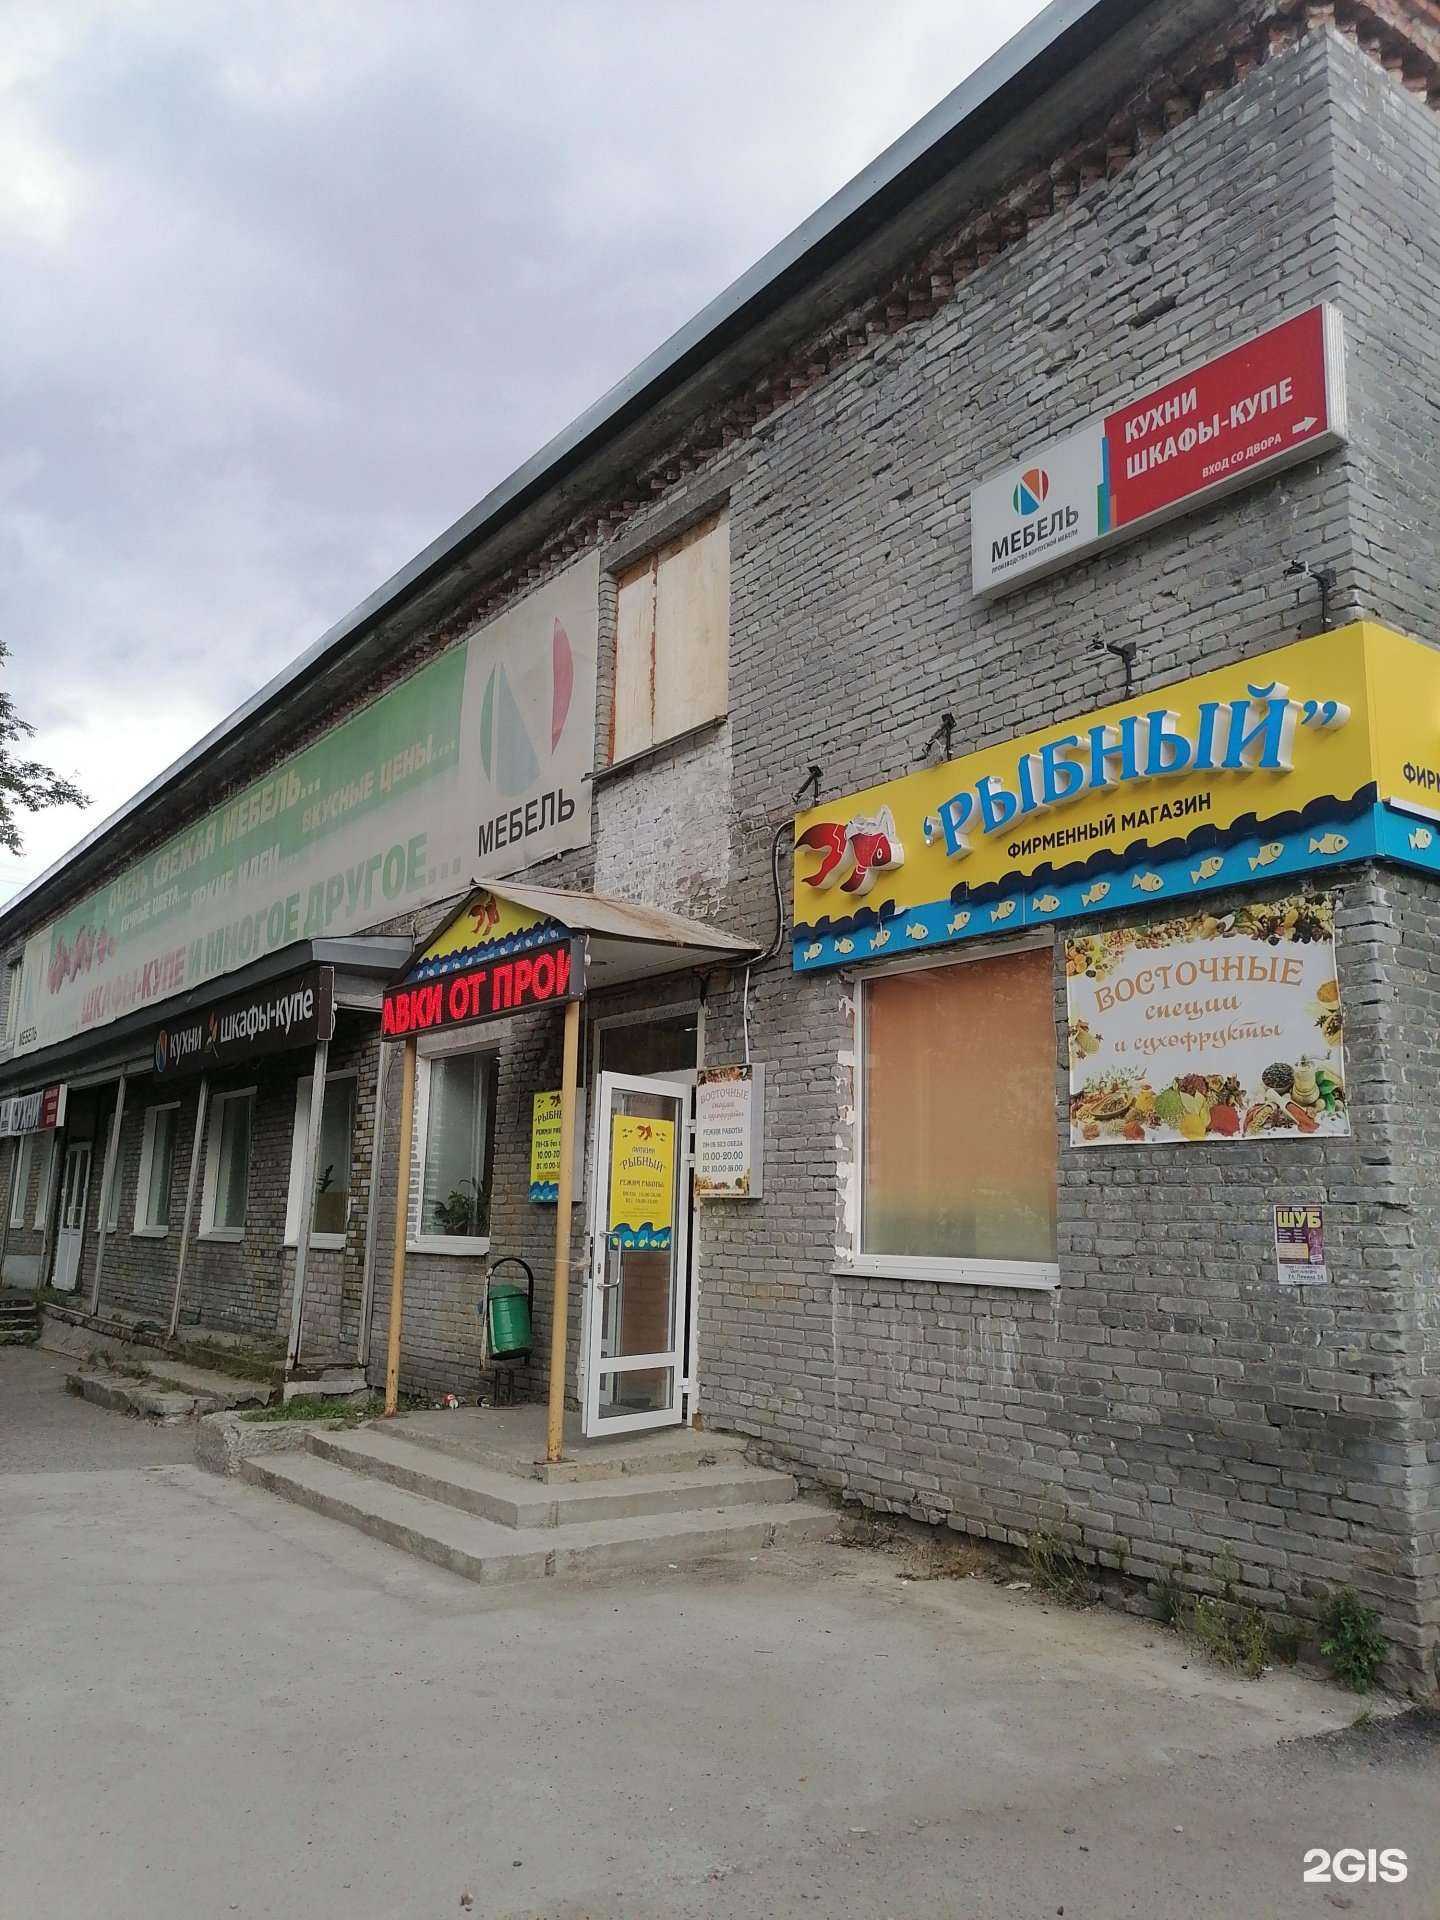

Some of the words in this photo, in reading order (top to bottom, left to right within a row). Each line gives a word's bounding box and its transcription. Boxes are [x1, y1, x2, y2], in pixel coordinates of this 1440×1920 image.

[1125, 387, 1197, 443] КУХНИ
[1126, 376, 1293, 479] ШКАФЫ-КУПЕ
[1202, 457, 1230, 478] ВХОД
[1231, 451, 1244, 464] СО
[1245, 433, 1282, 459] ДВОРА
[992, 505, 1079, 563] МЕБЕЛЬ
[478, 788, 576, 857] МЕБЕЛЬ
[1007, 814, 1116, 858] ФИРМЕННЫЙ
[1121, 792, 1212, 832] МАГАЗИН
[383, 983, 443, 1036] АВКИ
[450, 971, 487, 1020] ОТ
[1094, 955, 1304, 1014] ВОСТОЧНЫЕ
[1145, 993, 1242, 1021] специи
[169, 1025, 202, 1066] кухни
[219, 987, 314, 1042] шкафы-купе
[1134, 1017, 1284, 1056] сухофрукты
[1277, 1211, 1322, 1228] ШУБ
